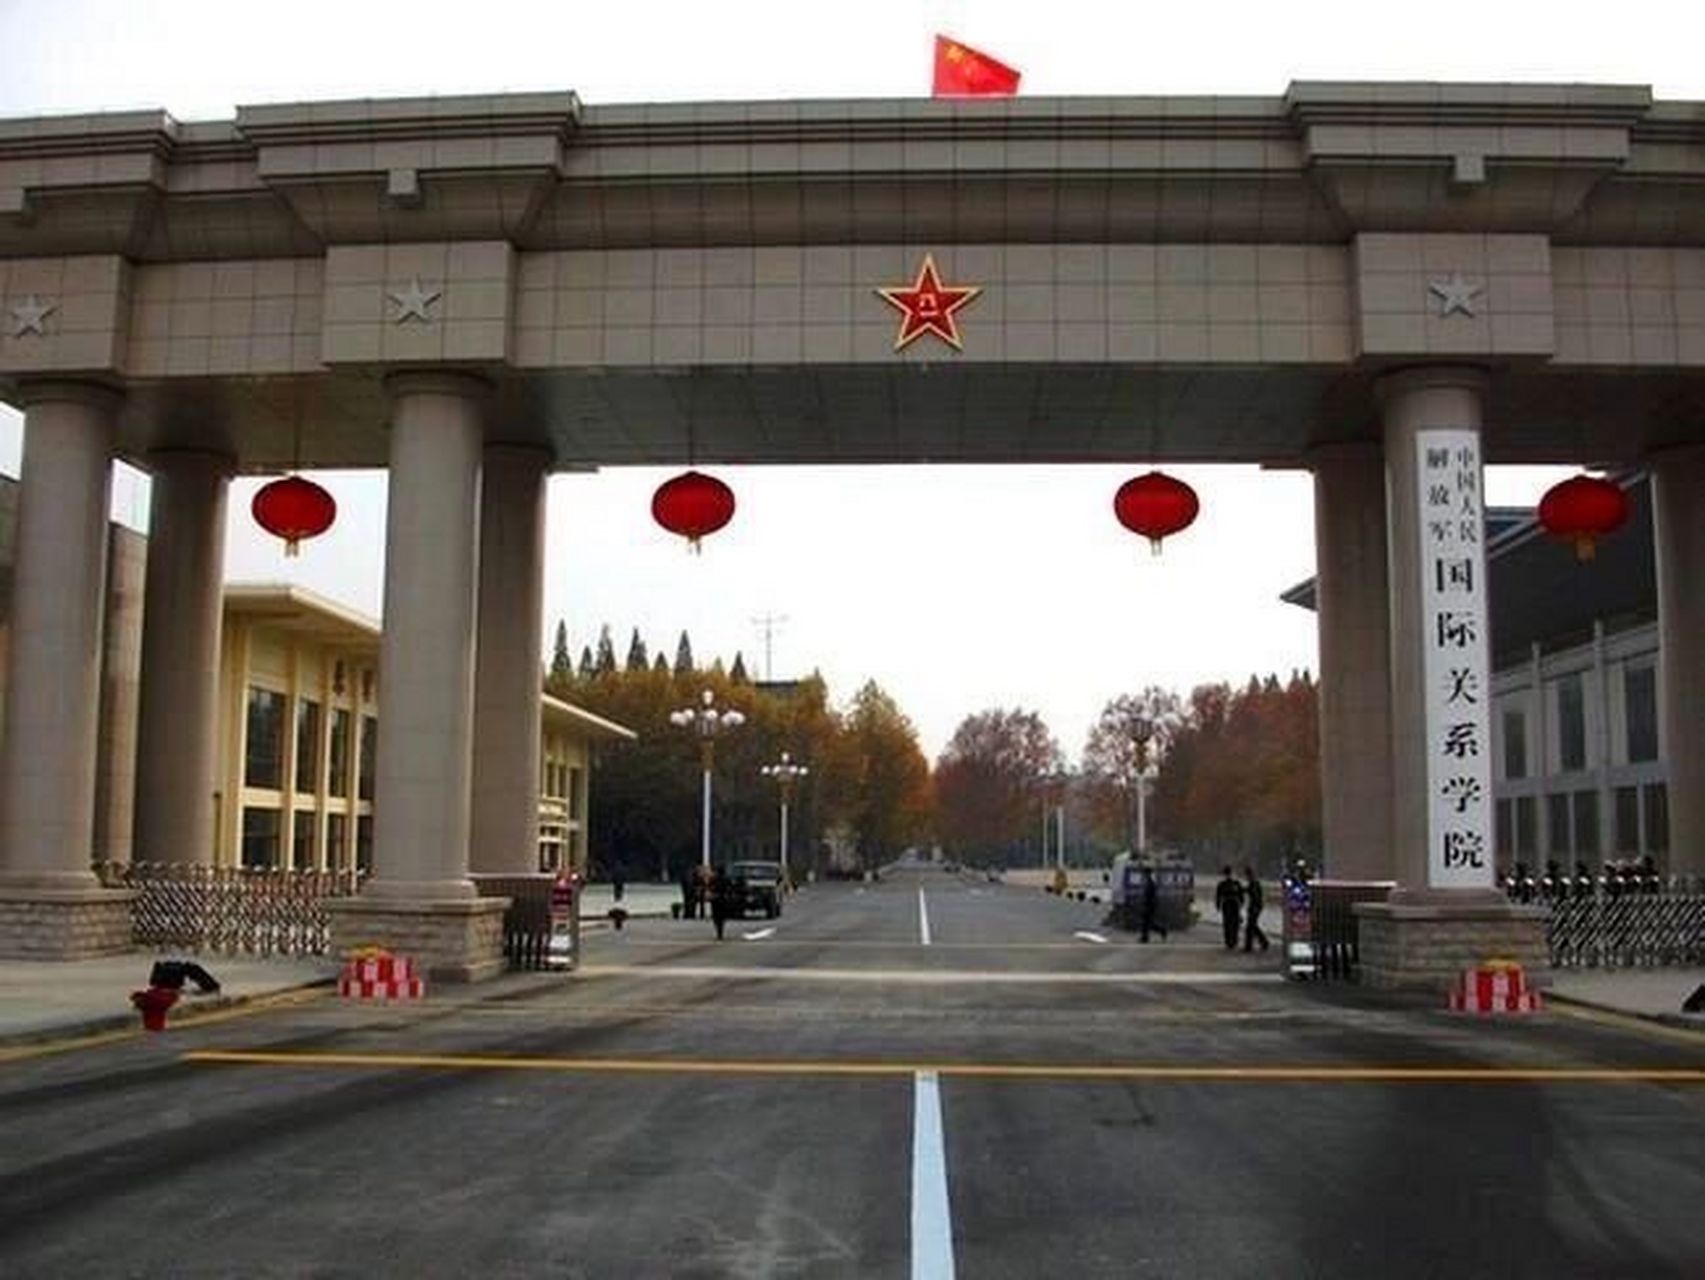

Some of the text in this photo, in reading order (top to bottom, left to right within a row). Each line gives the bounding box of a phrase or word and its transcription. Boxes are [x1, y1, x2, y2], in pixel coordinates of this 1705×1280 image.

[1426, 447, 1452, 542] 解放军
[1457, 446, 1477, 543] 中国人民
[1436, 557, 1484, 869] 国际关系学院
